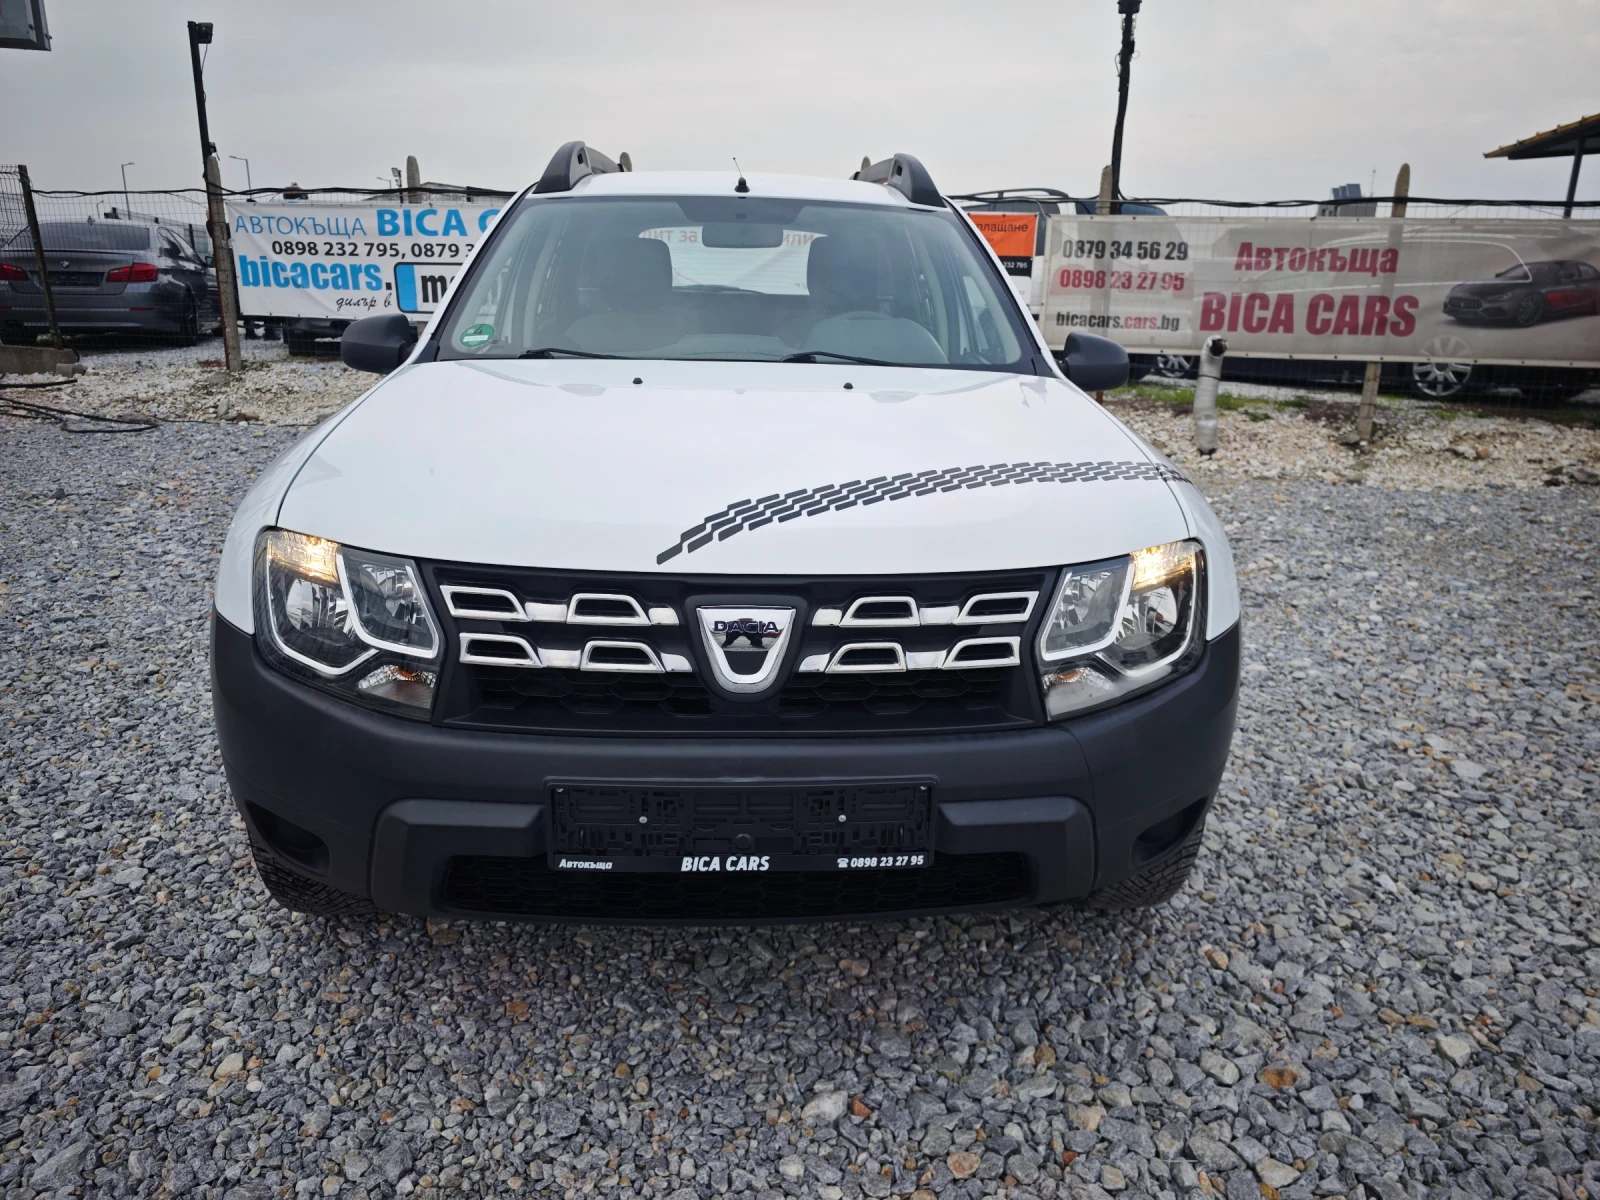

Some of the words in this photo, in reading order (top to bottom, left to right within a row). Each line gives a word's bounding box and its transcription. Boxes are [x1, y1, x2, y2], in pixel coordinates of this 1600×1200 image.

[235, 215, 367, 240] АВТОКЪЩА
[376, 208, 468, 237] BICA
[272, 240, 319, 257] 0898
[323, 241, 359, 257] 232
[365, 242, 406, 259] 795,
[411, 243, 460, 258] 0879
[1063, 239, 1106, 260] 0879
[1110, 240, 1134, 260] 34
[1136, 240, 1161, 260] 56
[1165, 241, 1189, 261] 29
[421, 275, 455, 303] m
[1059, 269, 1106, 289] 0898
[1110, 270, 1133, 290] 23
[1136, 271, 1158, 291] 27
[1161, 272, 1185, 291] 95
[1056, 312, 1180, 332] bicacars.cars.bg
[1199, 291, 1295, 335] BICA
[1305, 293, 1420, 338] CARS
[713, 620, 780, 634] DACIA
[681, 856, 721, 872] BICA
[725, 855, 770, 872] CARS
[850, 856, 877, 868] 0898
[880, 856, 894, 868] 23
[895, 855, 908, 867] 27
[910, 855, 924, 866] 95
